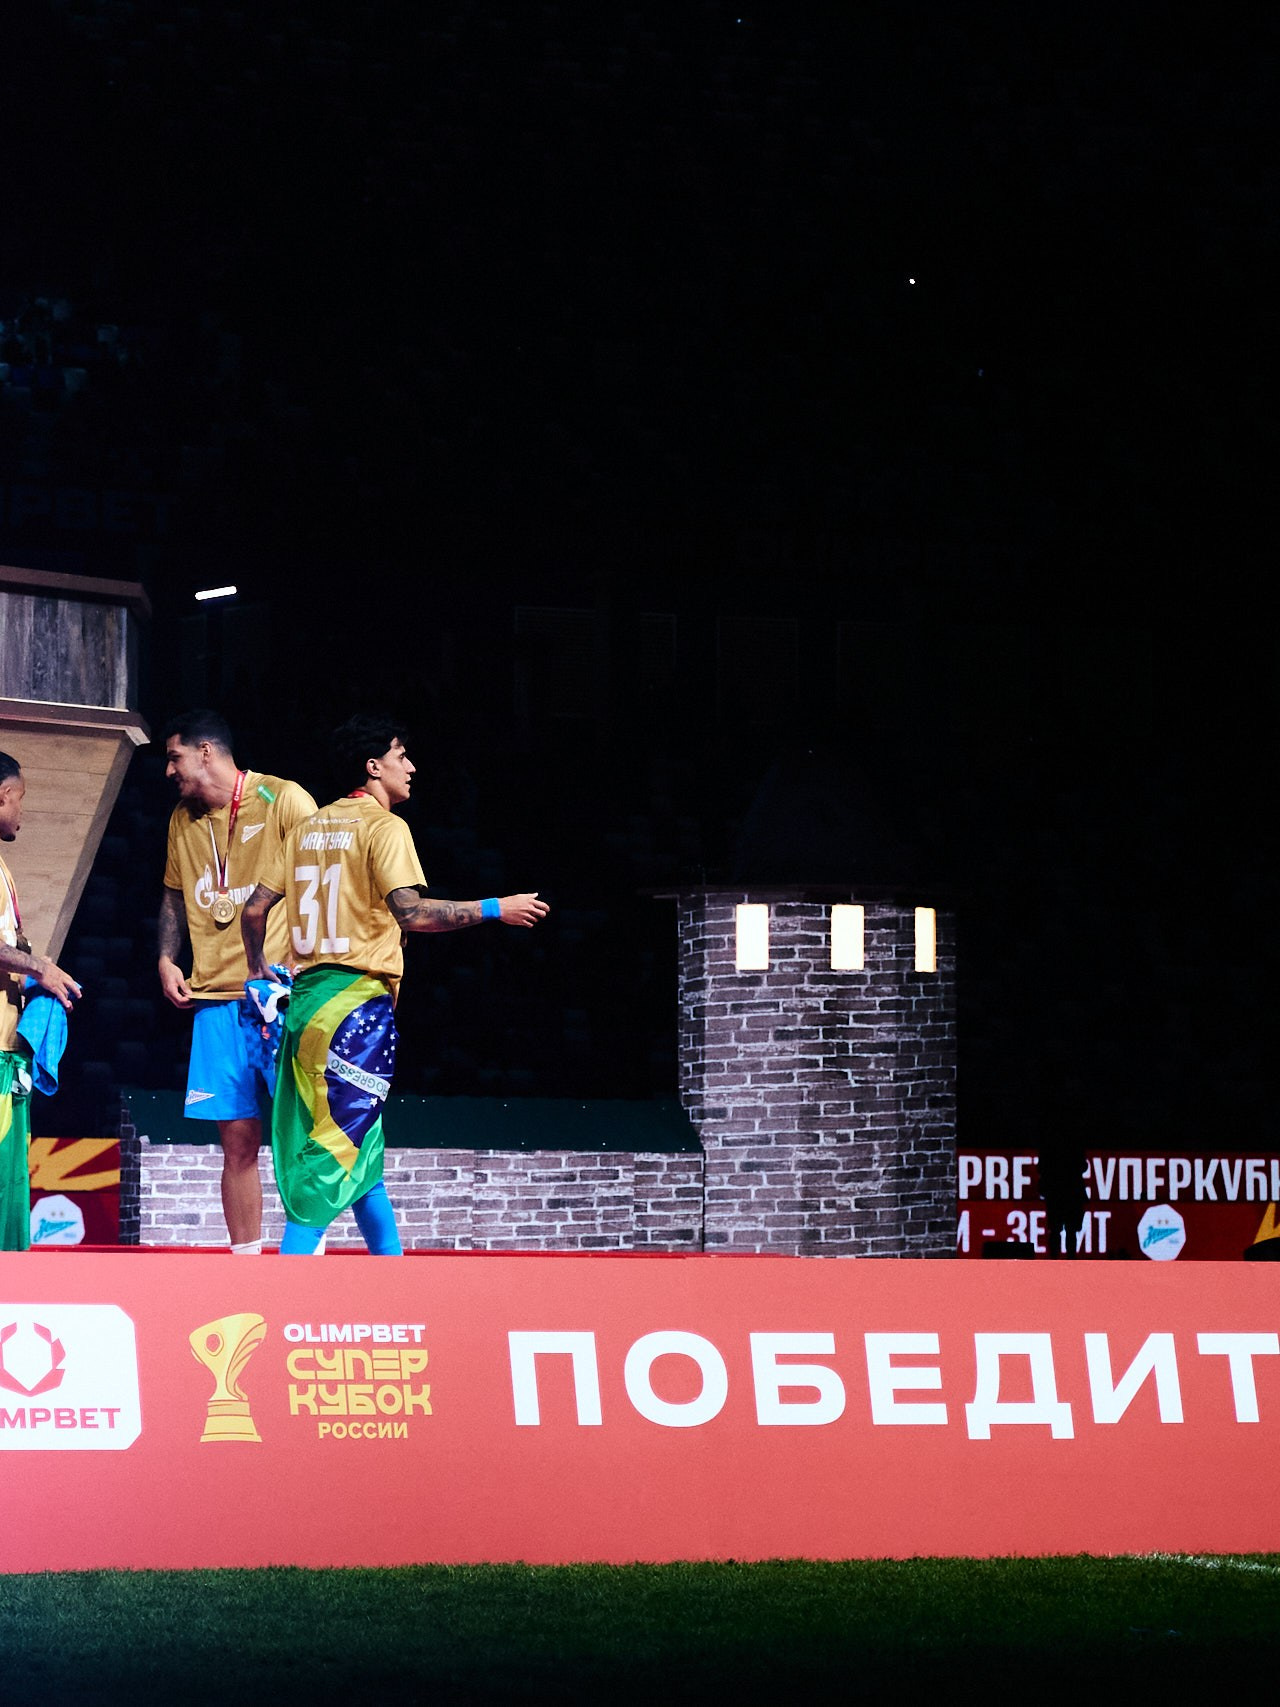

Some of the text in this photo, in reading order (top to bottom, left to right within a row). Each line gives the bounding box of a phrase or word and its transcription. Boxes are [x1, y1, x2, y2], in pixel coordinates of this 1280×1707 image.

[292, 863, 349, 955] 31
[284, 1324, 426, 1343] OLIMPBET
[286, 1349, 429, 1380] СУПЕР
[288, 1384, 433, 1416] КУБОК
[508, 1331, 1280, 1440] ПОБЕДИТ
[318, 1422, 408, 1439] РОССИИ
